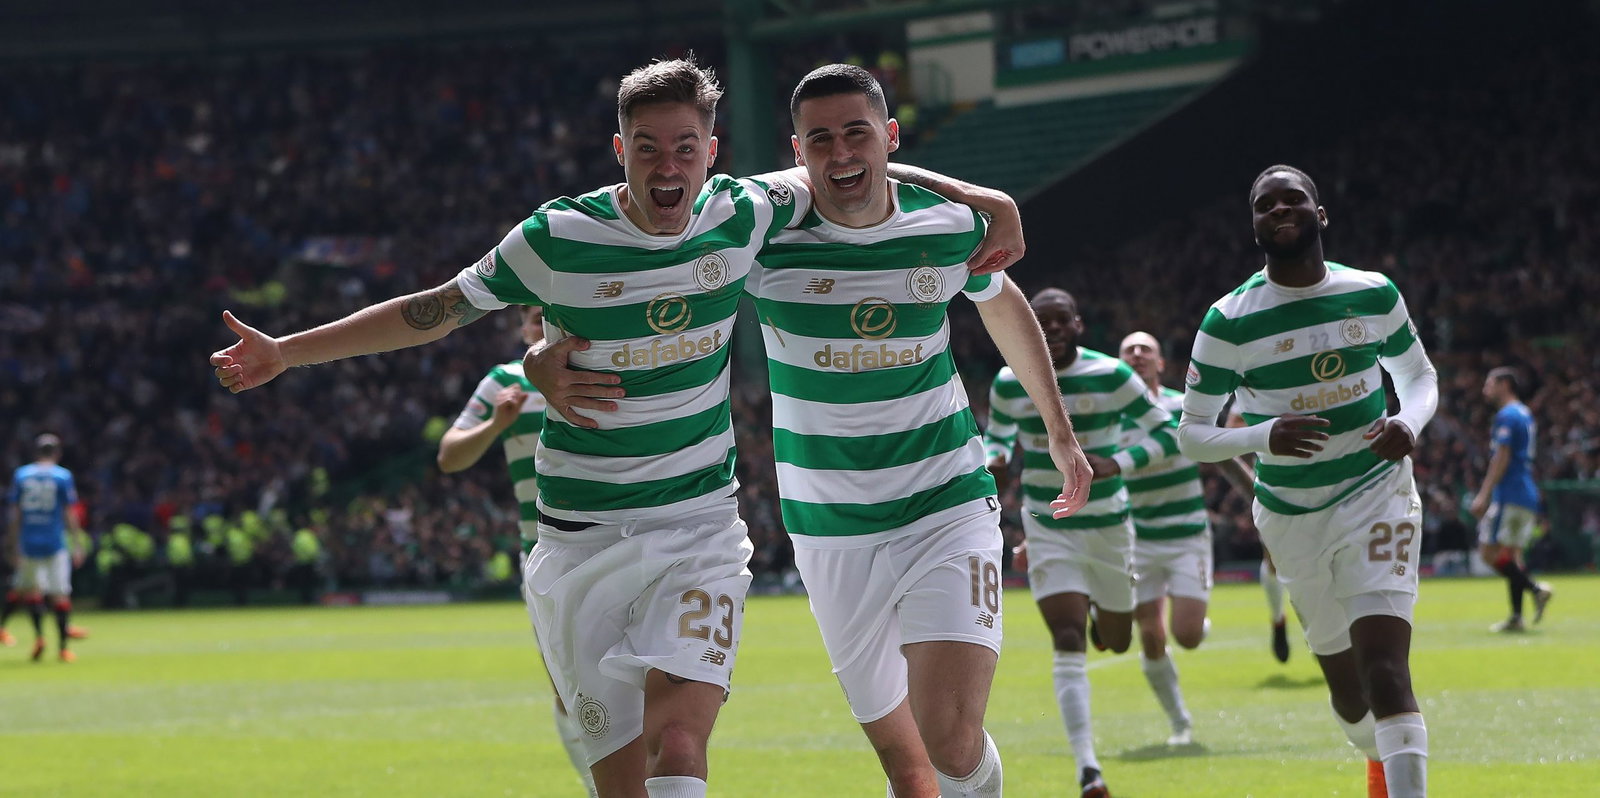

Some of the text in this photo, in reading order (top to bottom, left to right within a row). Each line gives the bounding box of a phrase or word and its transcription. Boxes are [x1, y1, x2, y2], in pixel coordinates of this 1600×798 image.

[611, 329, 722, 368] dafabet
[814, 342, 923, 373] dafabet
[1308, 332, 1331, 351] 22
[1290, 378, 1368, 411] dafabet
[1368, 521, 1415, 563] 22
[968, 555, 999, 615] 18
[678, 588, 734, 650] 23
